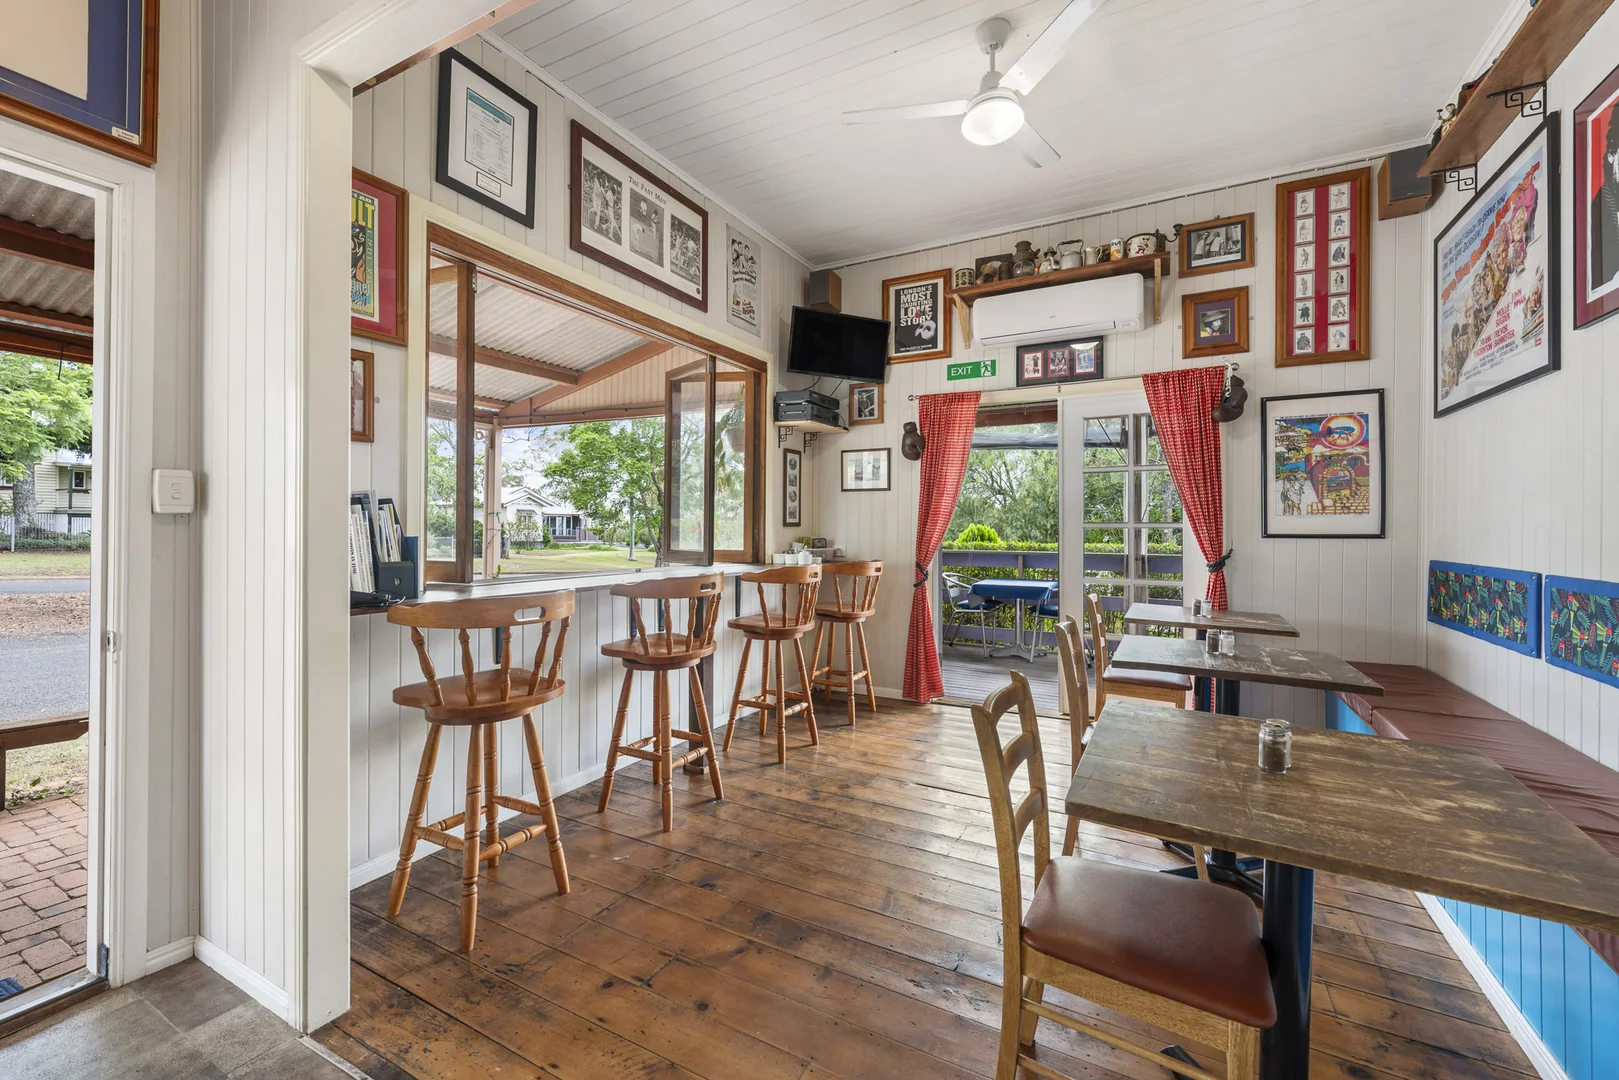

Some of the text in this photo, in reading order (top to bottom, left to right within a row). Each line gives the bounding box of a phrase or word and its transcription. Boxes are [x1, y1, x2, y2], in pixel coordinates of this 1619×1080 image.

[901, 285, 933, 296] LONDON'S
[900, 291, 933, 304] MOST
[900, 299, 933, 310] HAUNTING
[900, 304, 933, 319] LOVE
[900, 314, 933, 327] STORY
[951, 366, 973, 377] EXIT
